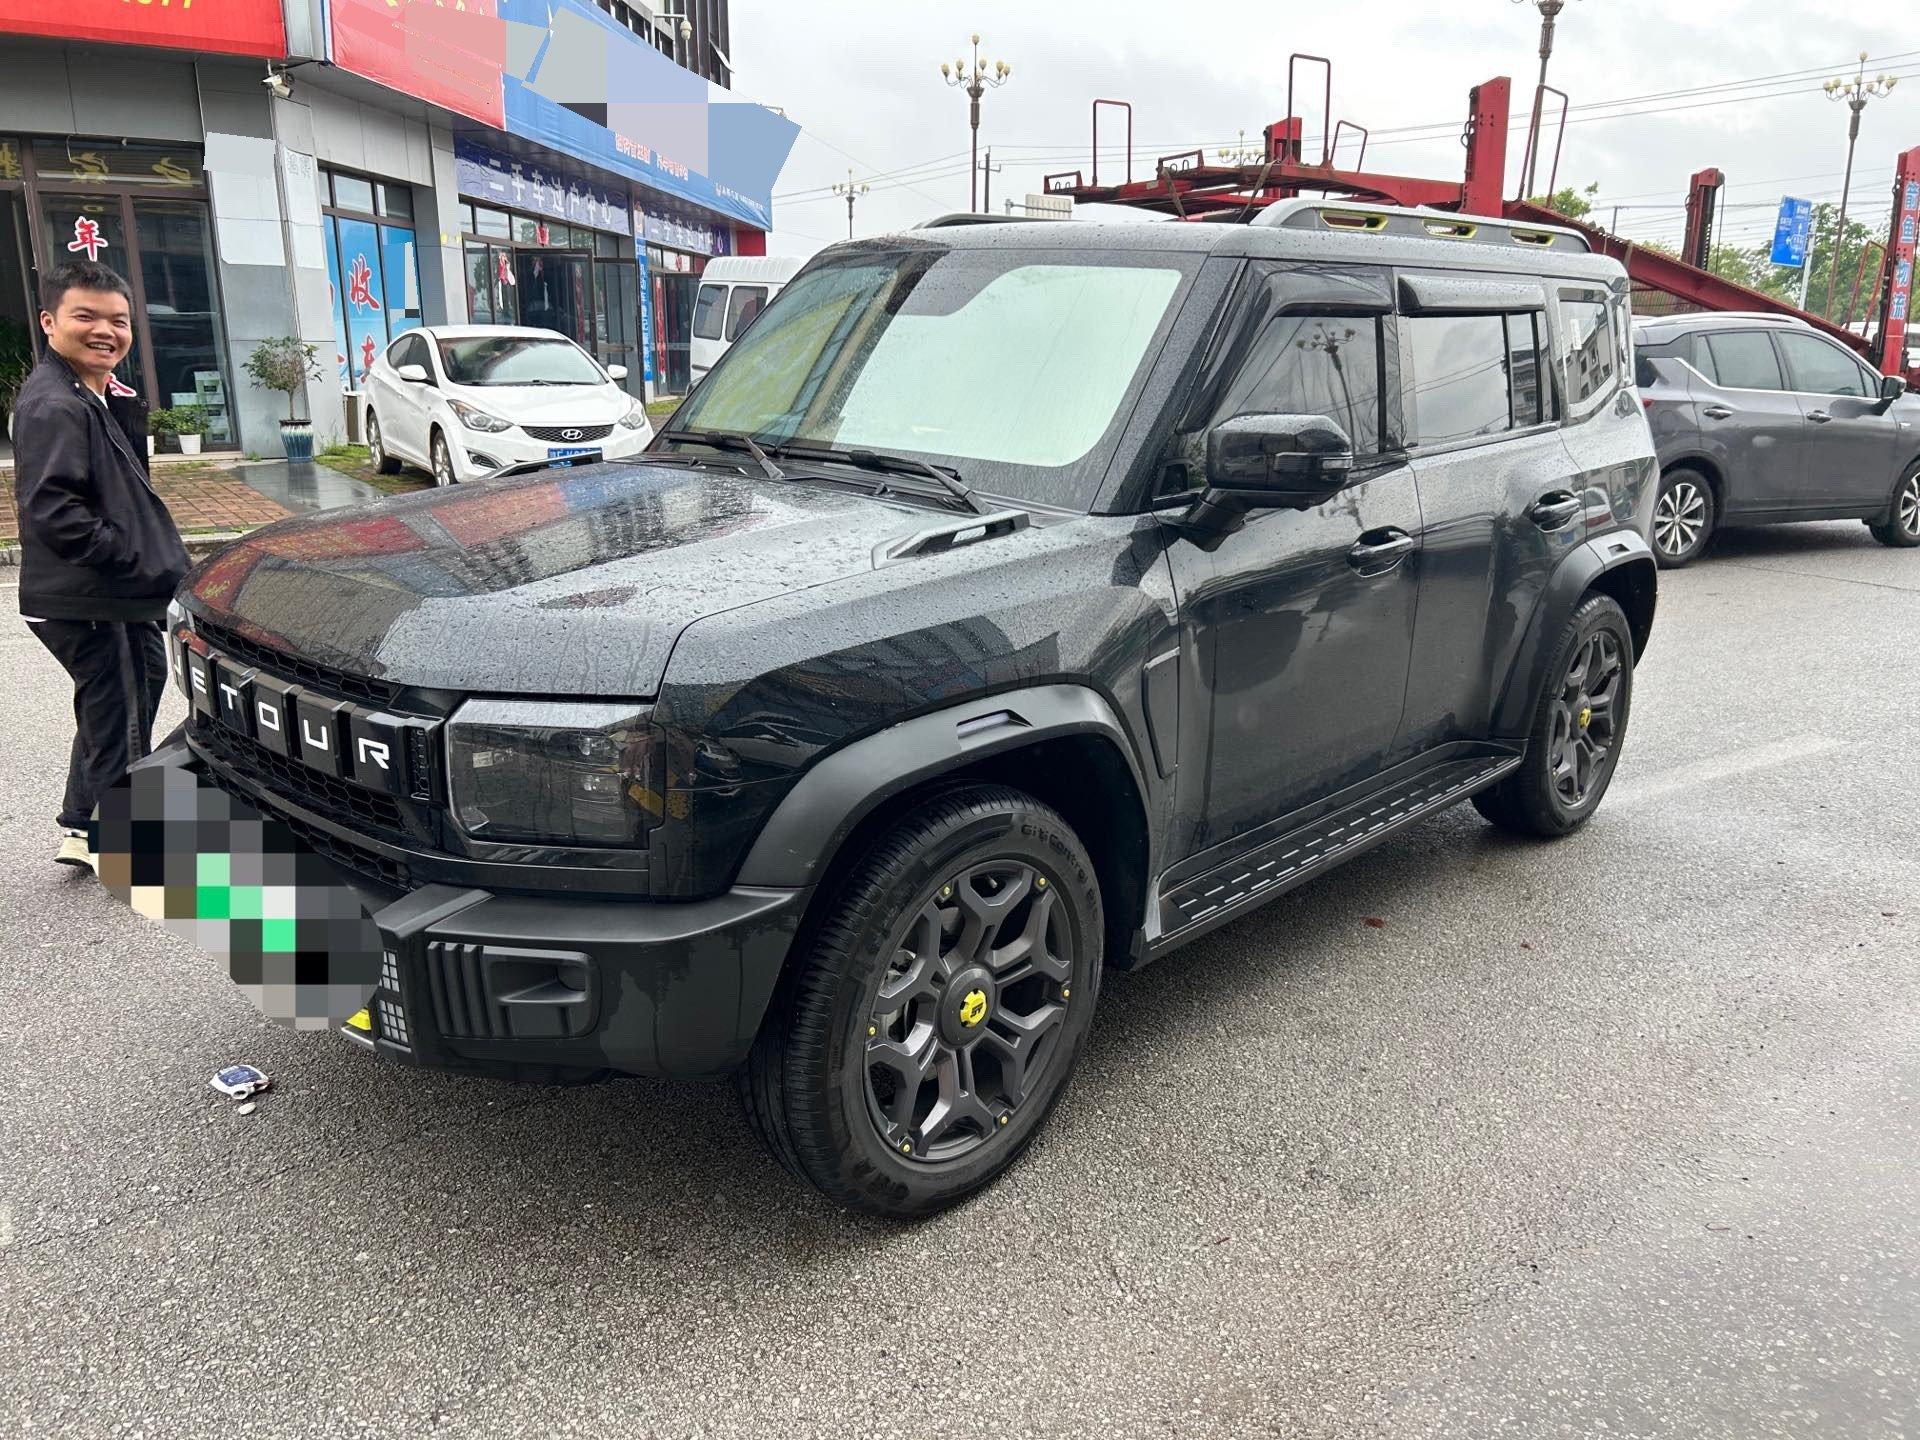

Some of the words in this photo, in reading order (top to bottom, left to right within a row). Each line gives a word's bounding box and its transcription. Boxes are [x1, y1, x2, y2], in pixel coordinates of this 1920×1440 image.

[68, 216, 109, 263] 年
[349, 253, 380, 315] 收
[173, 654, 390, 770] JETOUR
